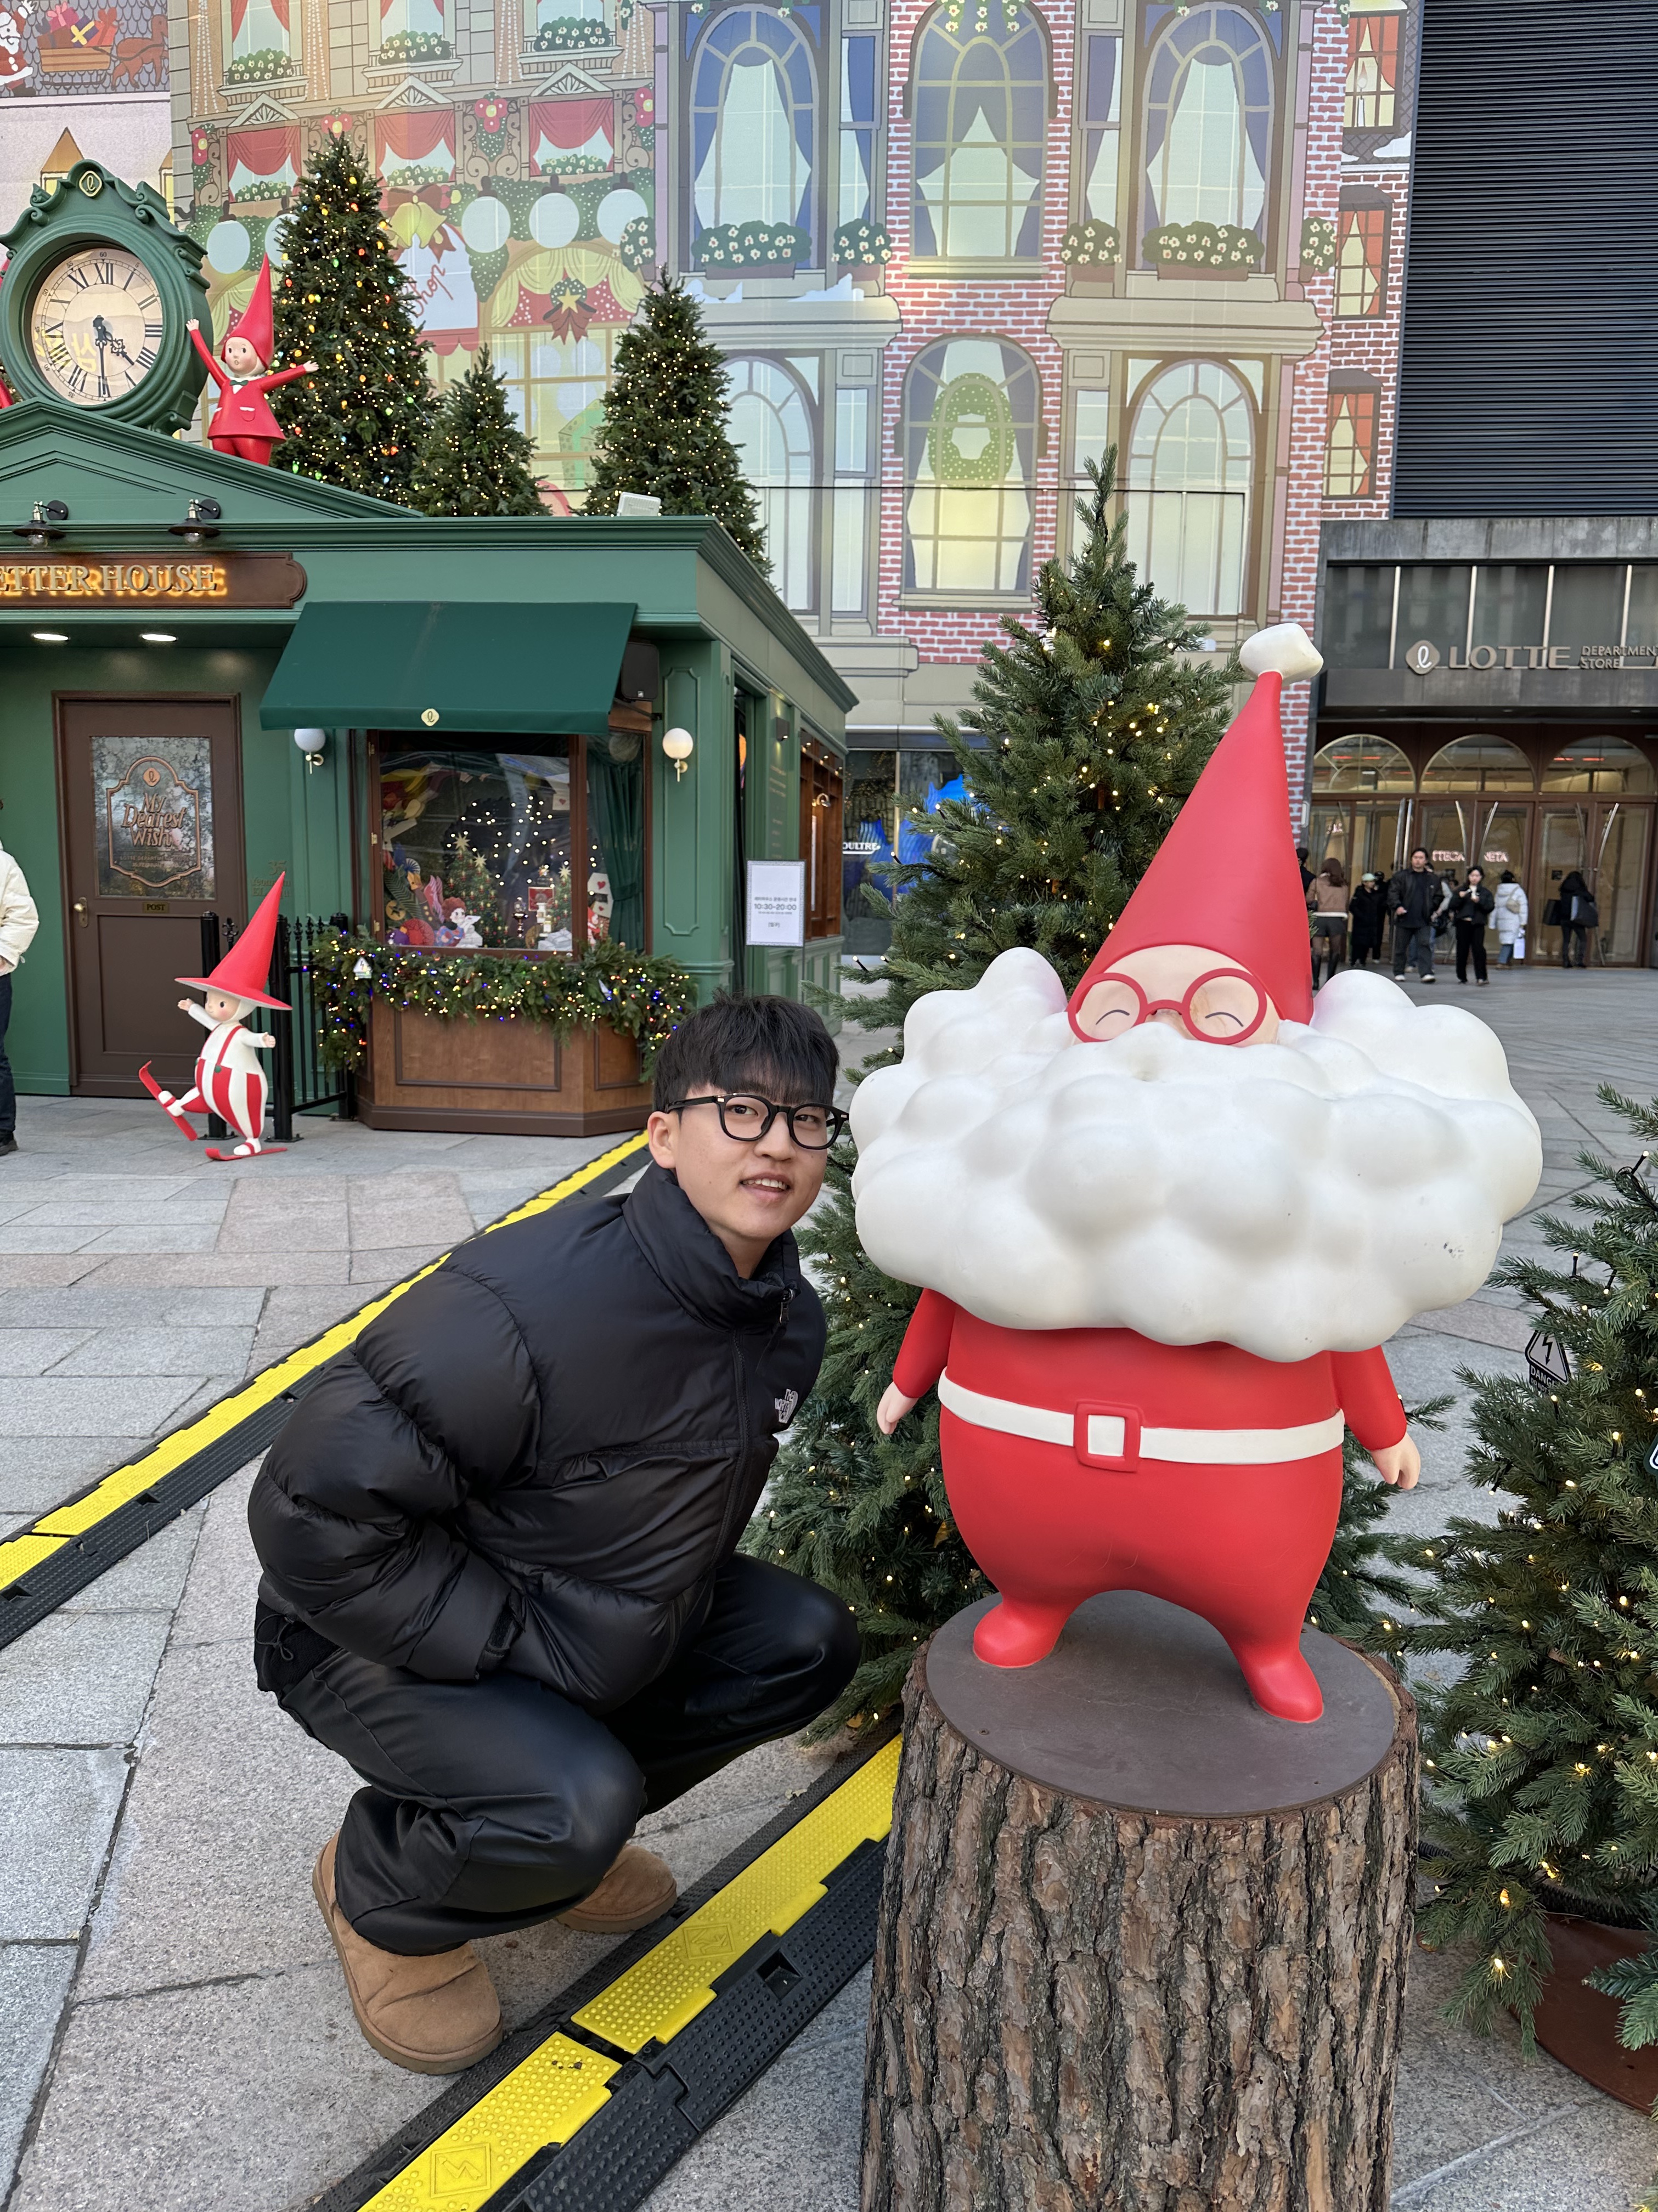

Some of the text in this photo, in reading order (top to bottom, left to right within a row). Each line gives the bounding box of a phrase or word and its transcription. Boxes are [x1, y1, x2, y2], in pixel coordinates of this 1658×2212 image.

[99, 565, 217, 591] HOUSE
[1448, 645, 1571, 669] LOTTE
[1580, 657, 1620, 669] STORE
[139, 792, 166, 813] My
[121, 803, 187, 829] Dearest
[129, 825, 173, 847] Wish
